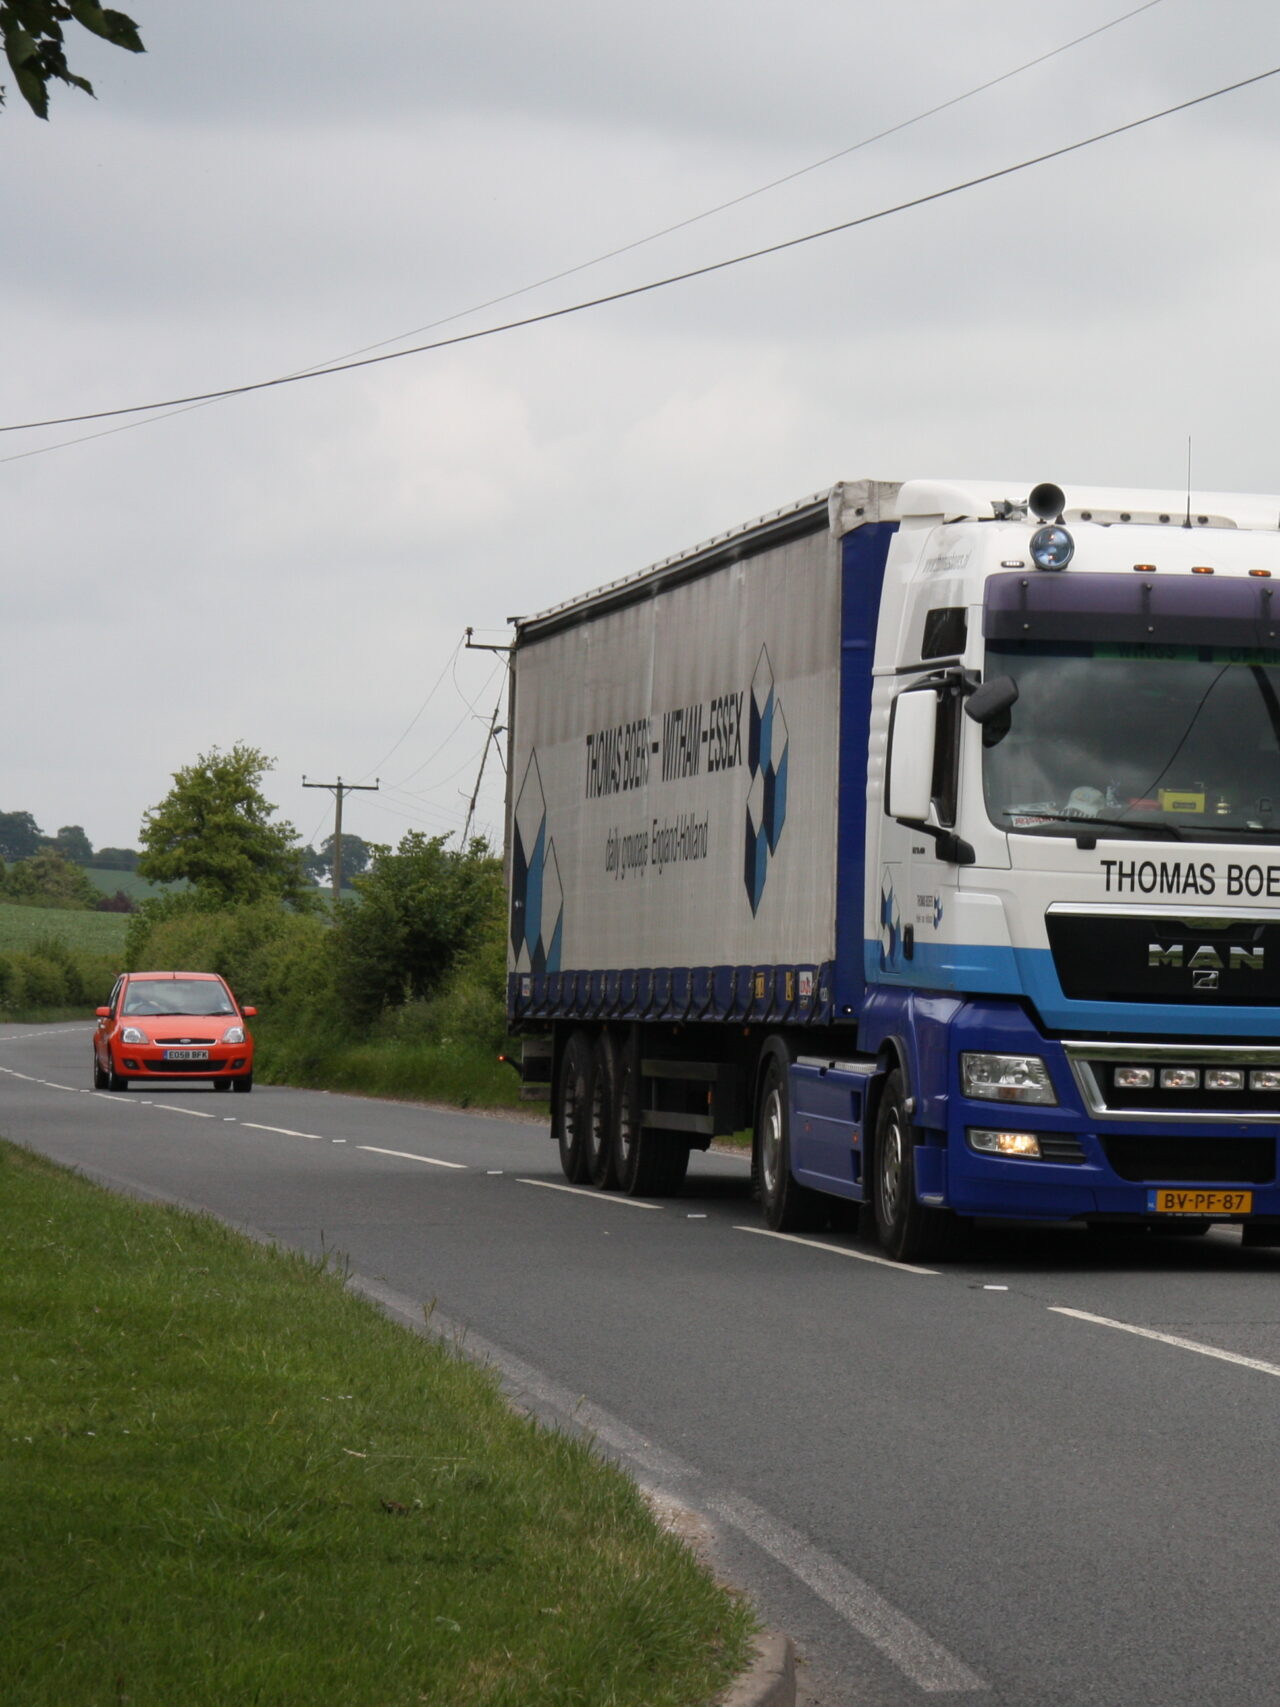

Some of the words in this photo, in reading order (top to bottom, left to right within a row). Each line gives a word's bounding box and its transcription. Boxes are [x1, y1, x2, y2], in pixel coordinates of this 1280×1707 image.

[586, 724, 624, 799] THOMAS
[1100, 860, 1216, 896] THOMAS
[1148, 943, 1264, 969] MAN
[1164, 1192, 1245, 1210] BV-PF-87
